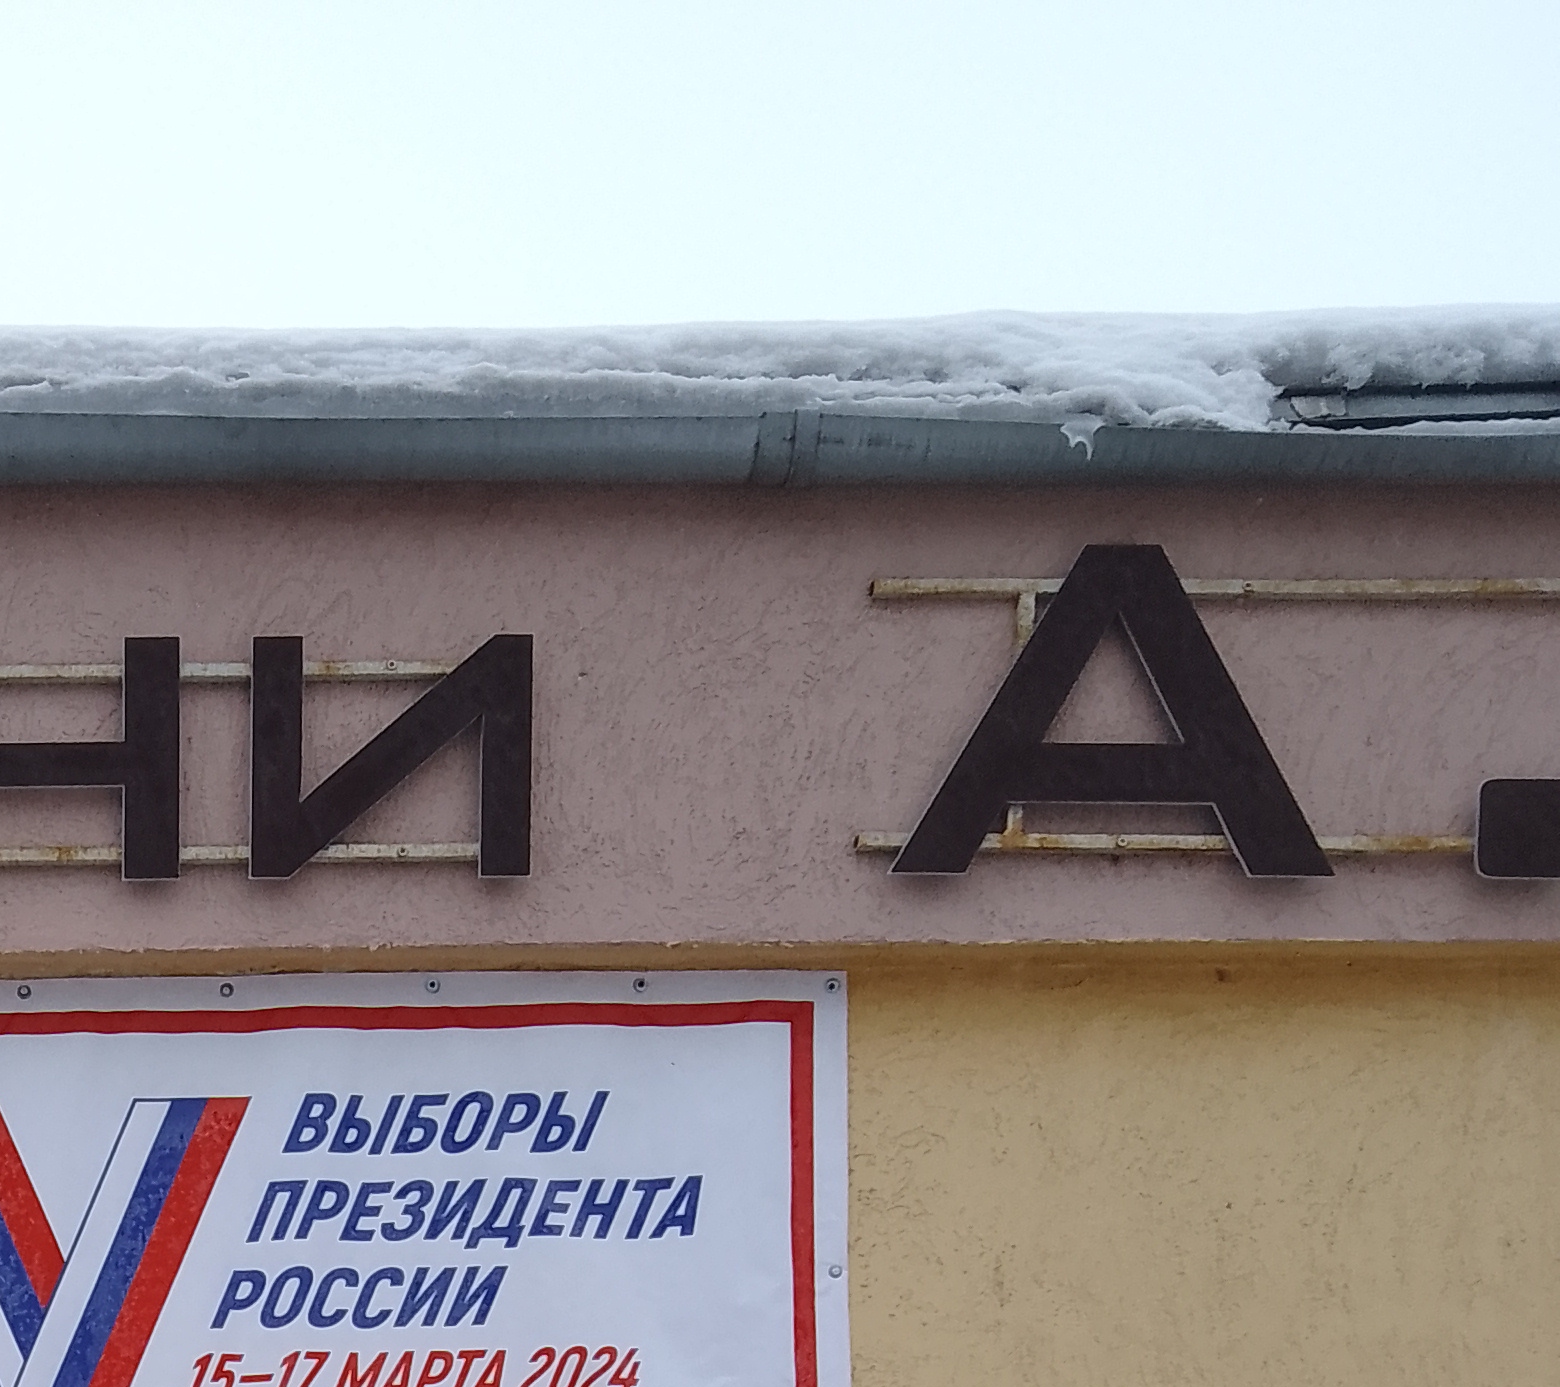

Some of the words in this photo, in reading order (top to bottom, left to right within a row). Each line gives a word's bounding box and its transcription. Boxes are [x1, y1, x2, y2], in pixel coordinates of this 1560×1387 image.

[282, 1090, 610, 1156] ВЫБОРЫ
[245, 1175, 703, 1250] ПРЕЗИДЕНТА
[210, 1265, 509, 1329] РОССИИ
